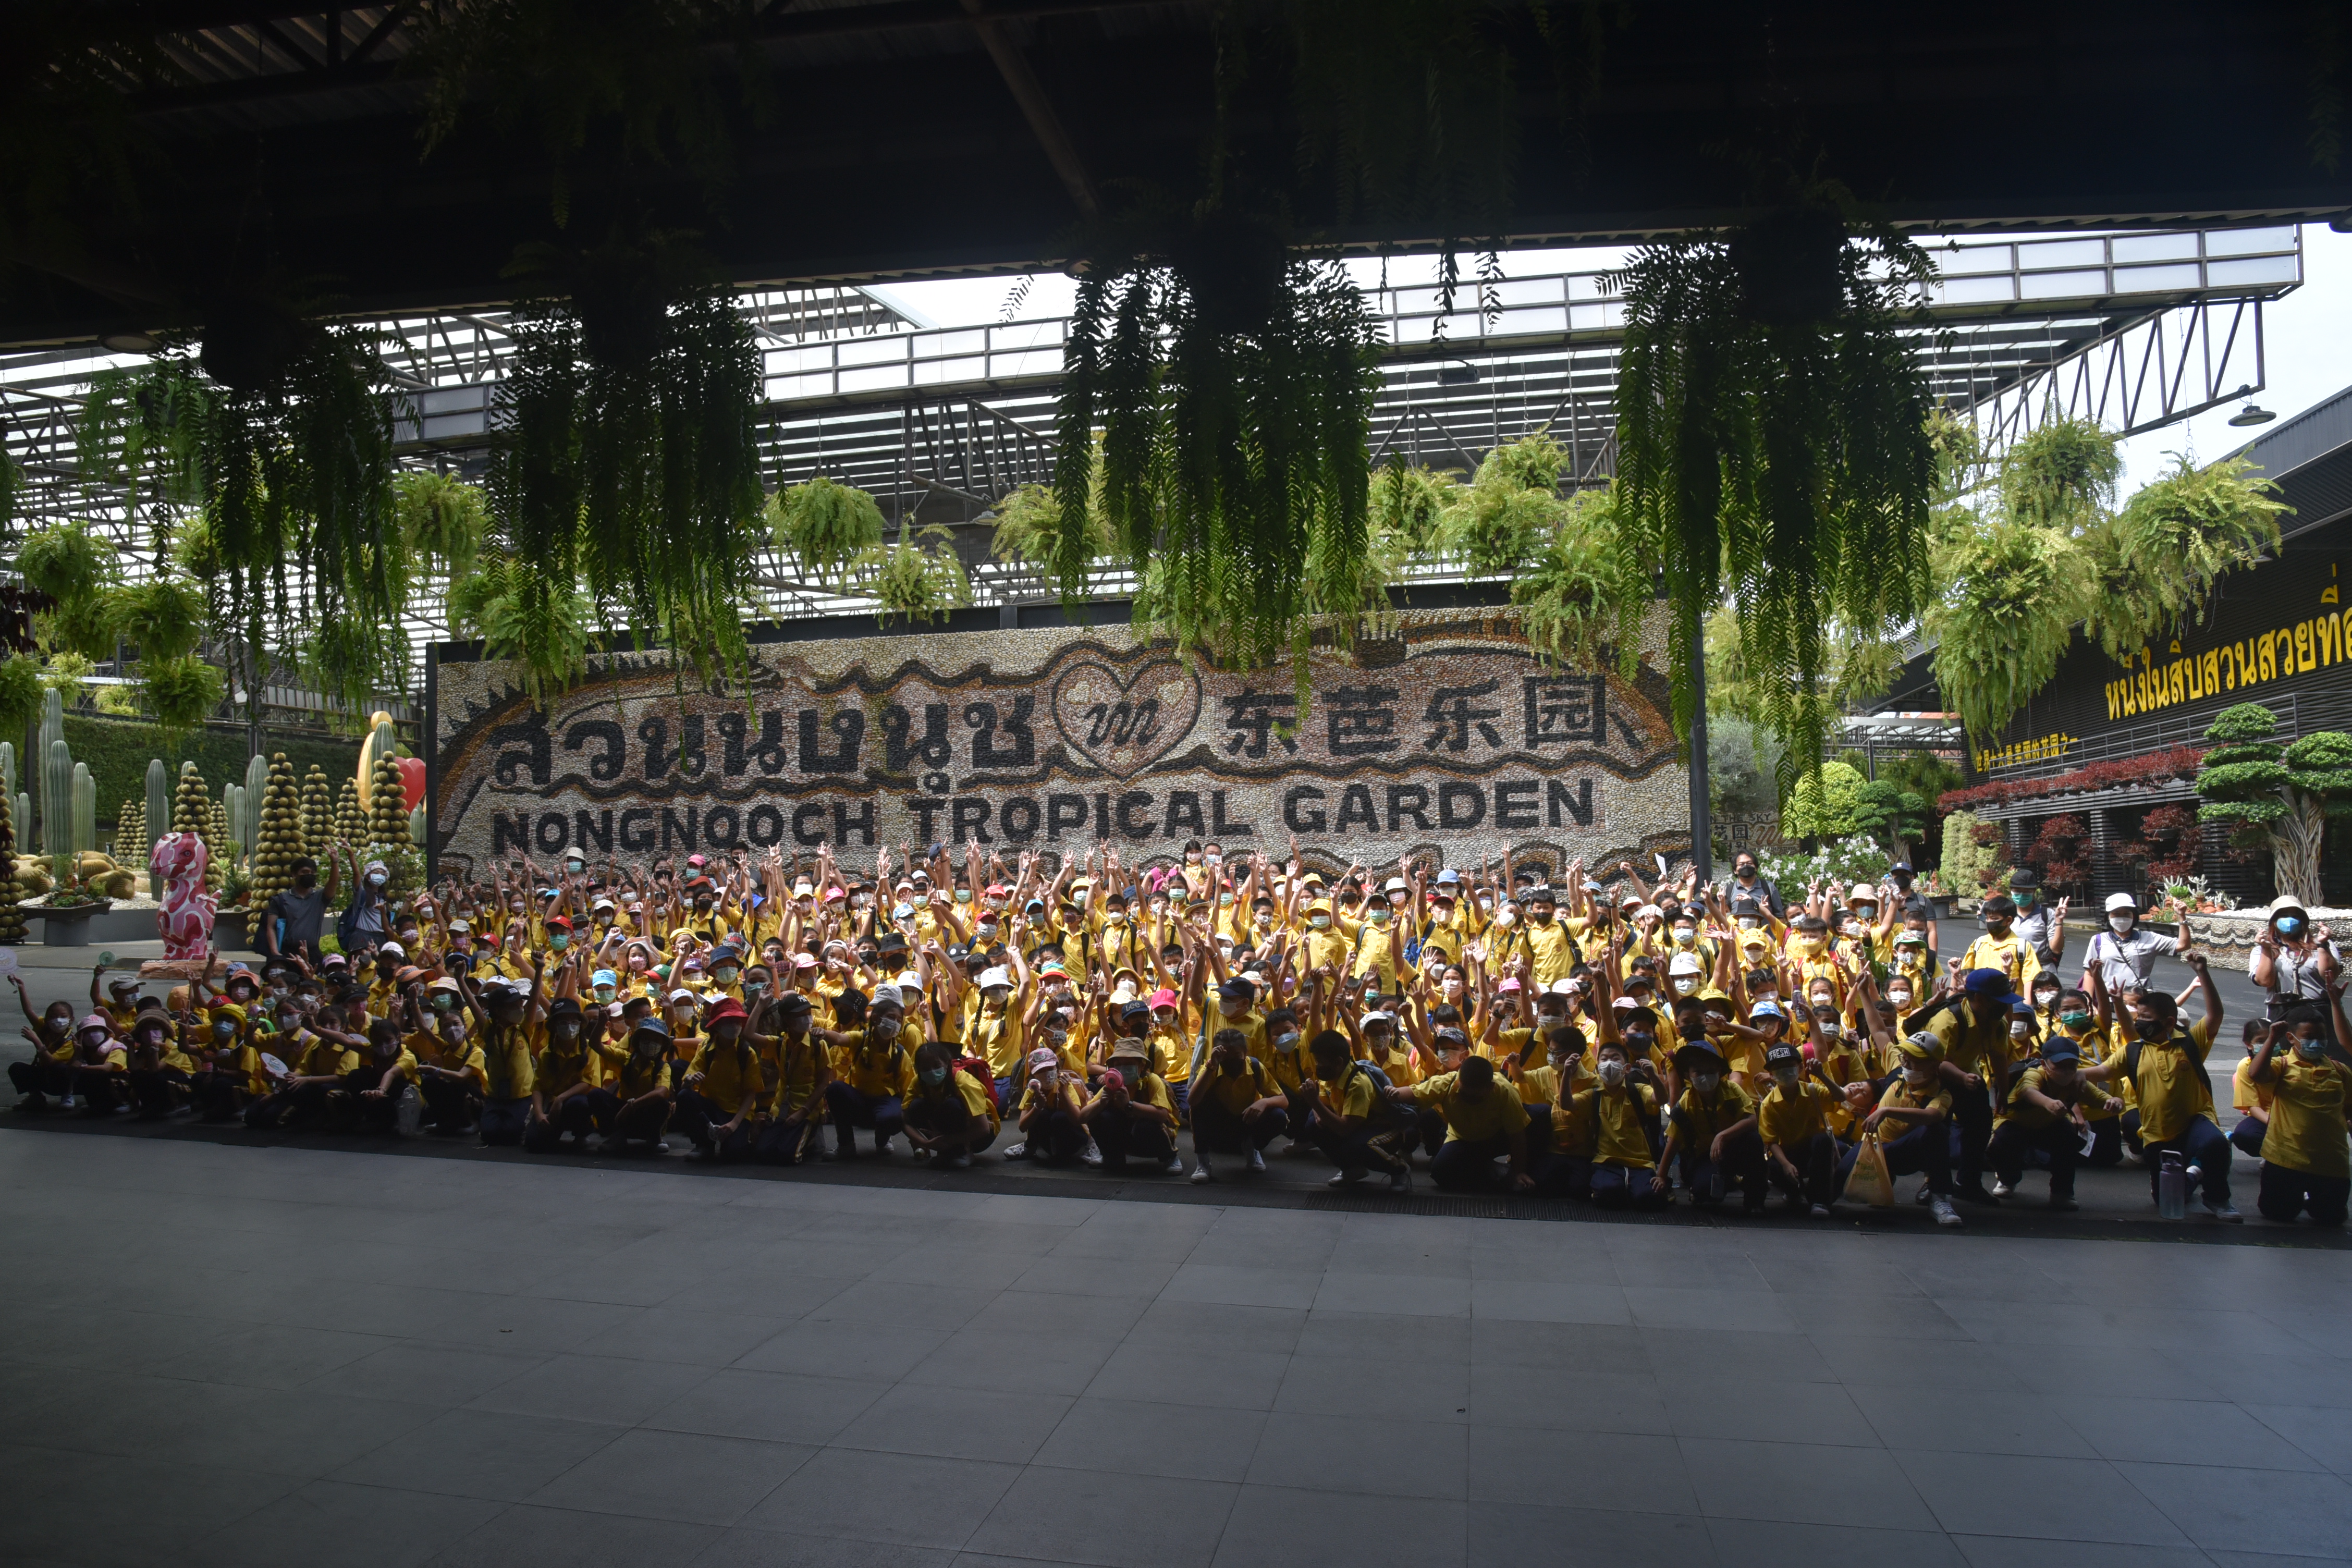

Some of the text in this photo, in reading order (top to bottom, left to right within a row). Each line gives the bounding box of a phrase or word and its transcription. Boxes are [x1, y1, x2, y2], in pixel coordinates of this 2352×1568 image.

[1222, 675, 1606, 758] 东芭乐园
[494, 777, 1593, 855] NONGNOOCH TROPICAL GARDEN
[1721, 813, 1743, 823] THE
[1749, 812, 1771, 822] SKY
[1125, 1002, 1141, 1012] Lee
[1913, 1033, 1926, 1044] TA
[1769, 1049, 1789, 1060] FRESH
